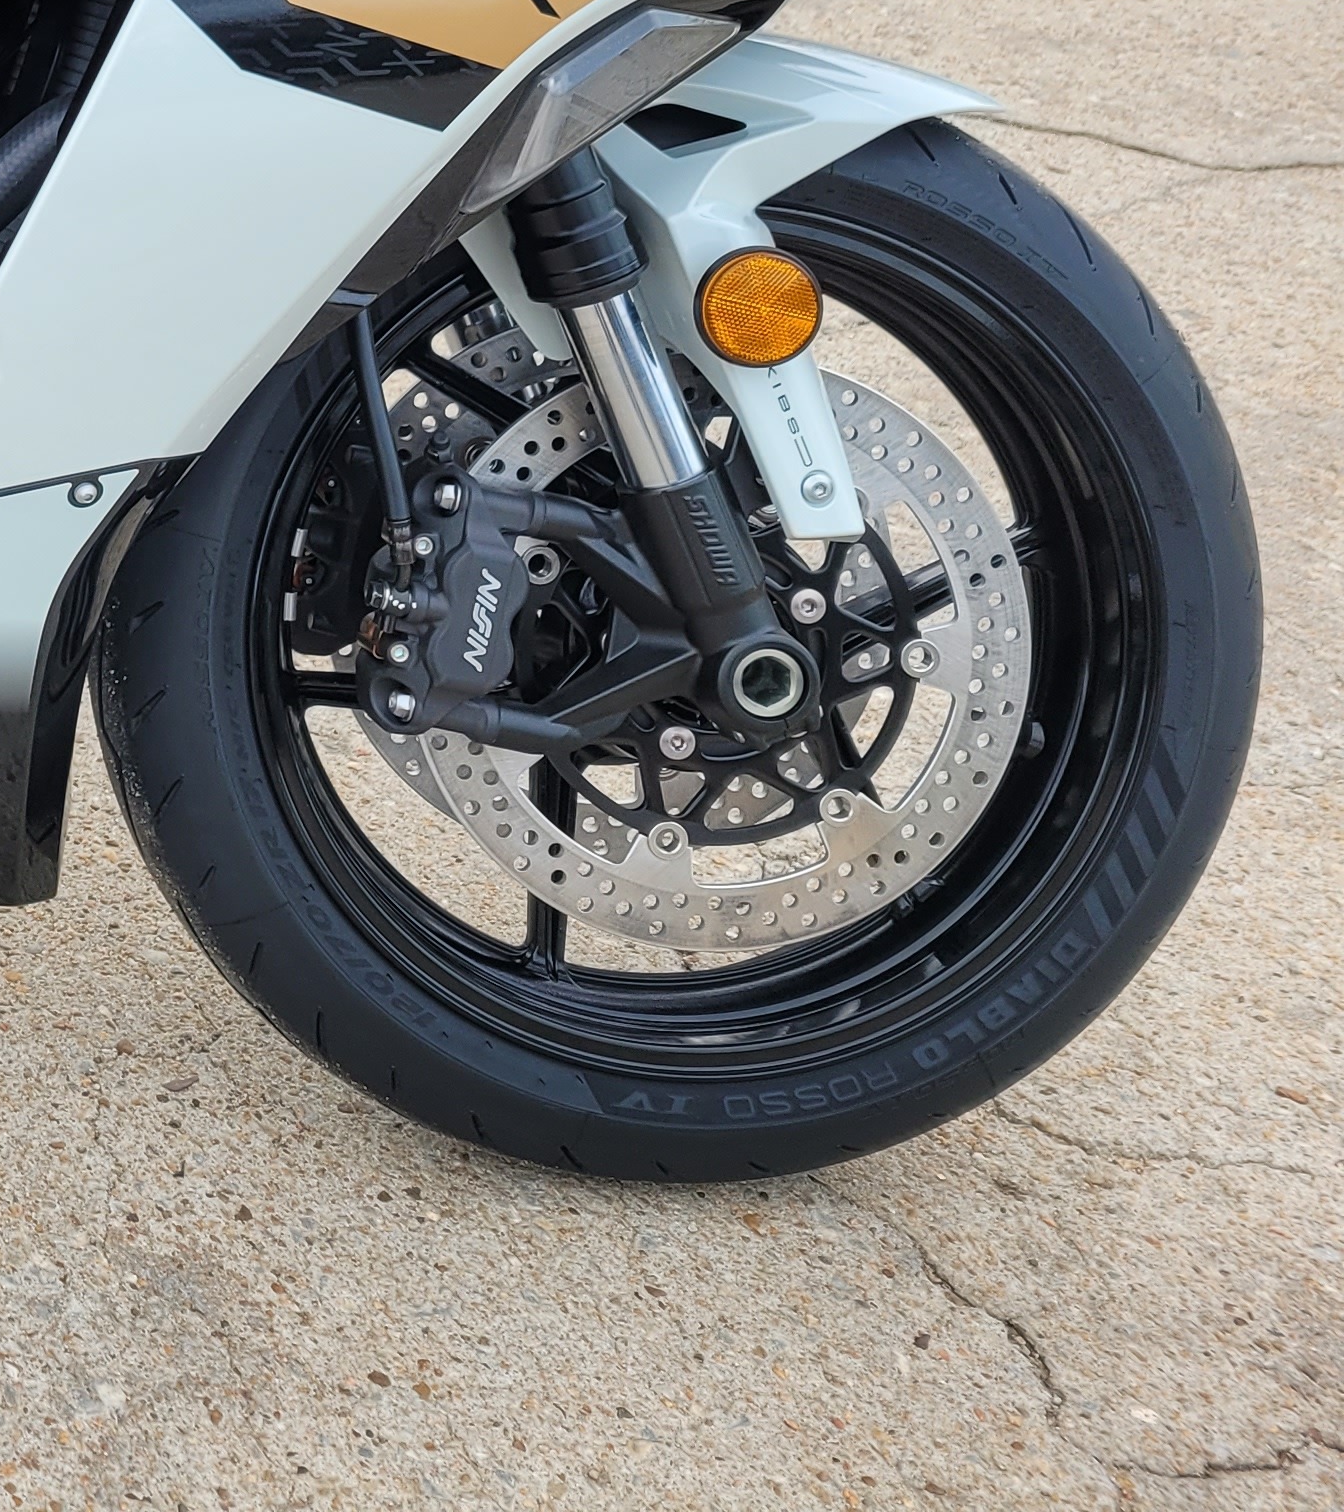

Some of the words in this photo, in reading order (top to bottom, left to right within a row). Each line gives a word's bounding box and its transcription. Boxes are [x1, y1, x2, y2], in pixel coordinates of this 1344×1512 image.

[911, 929, 1092, 1072] DIABLO
[613, 1090, 696, 1116] IV
[723, 1061, 898, 1120] ROSSO
